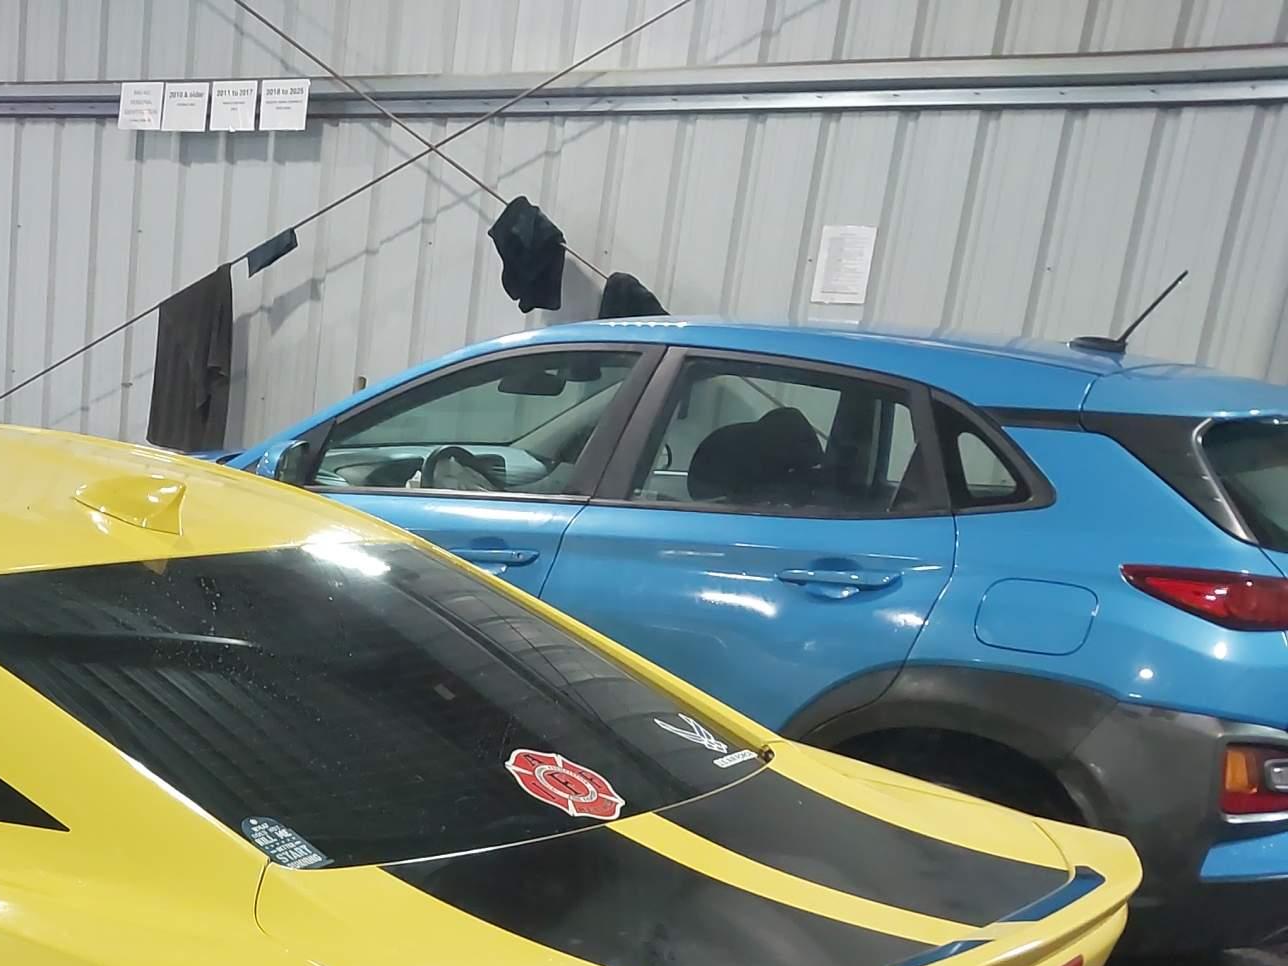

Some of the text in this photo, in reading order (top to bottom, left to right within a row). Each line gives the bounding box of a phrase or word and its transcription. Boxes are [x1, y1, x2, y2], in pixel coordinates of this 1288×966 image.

[217, 89, 231, 97] 2011
[239, 88, 253, 97] 2017
[266, 88, 281, 96] 2018
[254, 834, 278, 847] KILL
[275, 844, 313, 864] START
